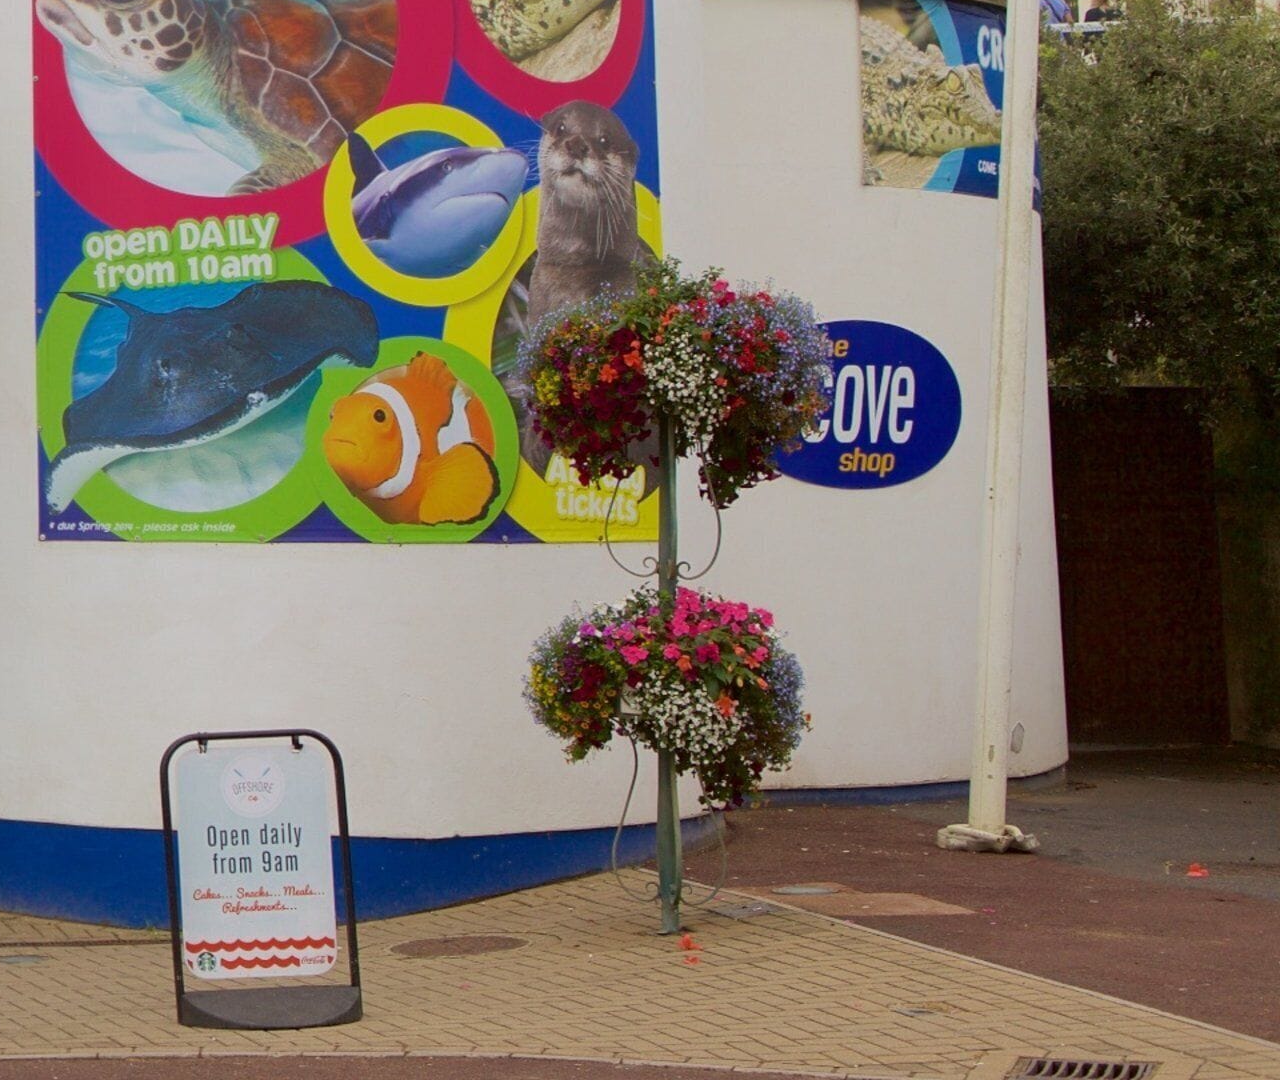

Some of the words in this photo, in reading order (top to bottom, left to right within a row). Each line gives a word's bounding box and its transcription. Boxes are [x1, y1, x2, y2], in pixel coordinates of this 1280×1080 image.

[85, 229, 169, 261] open
[179, 216, 276, 251] DAILY
[94, 260, 175, 289] from
[187, 253, 273, 281] 10am
[838, 447, 896, 478] shop
[555, 485, 638, 524] tickets
[57, 522, 76, 531] due
[77, 521, 111, 533] Spring
[143, 521, 177, 534] please
[181, 522, 199, 532] ask
[202, 521, 236, 533] inside
[206, 825, 250, 851] Open
[259, 822, 302, 848] daily
[212, 852, 252, 874] from
[262, 850, 299, 873] 9am
